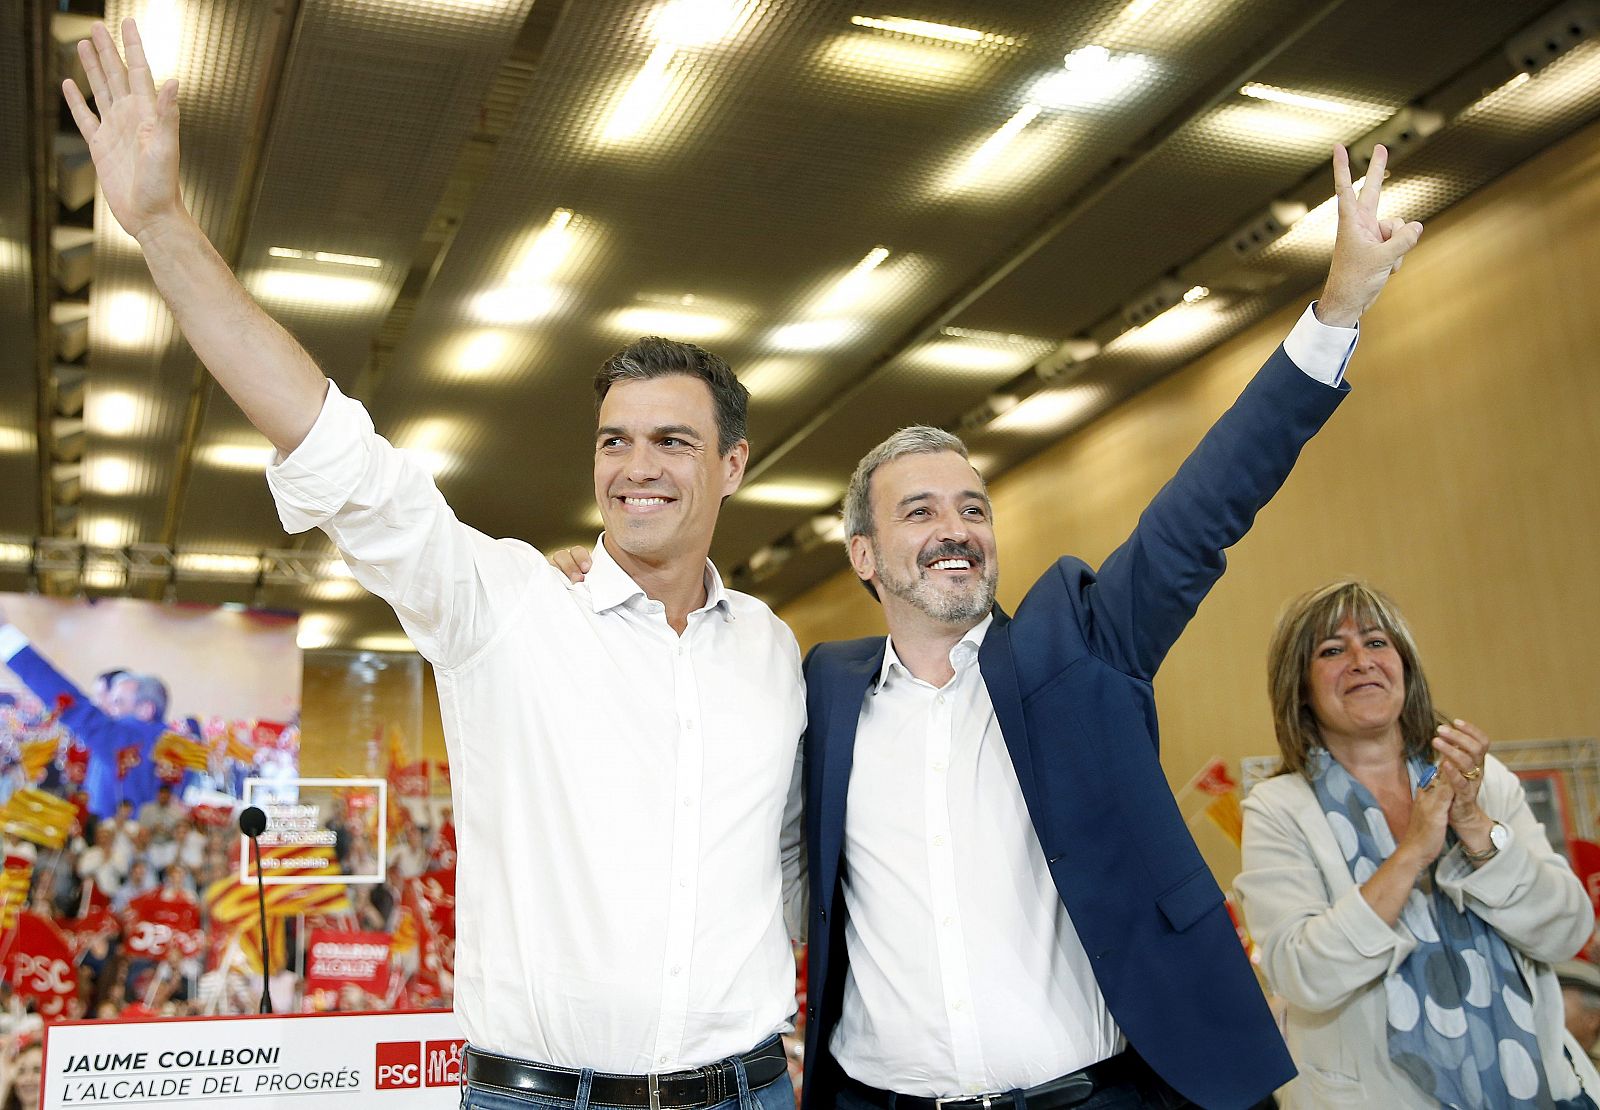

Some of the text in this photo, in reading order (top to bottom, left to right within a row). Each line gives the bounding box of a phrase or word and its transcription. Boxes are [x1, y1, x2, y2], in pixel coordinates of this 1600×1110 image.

[312, 942, 390, 960] COLLBONI
[12, 951, 76, 994] PSC
[311, 960, 378, 978] ALCALDE
[62, 1047, 281, 1073] JAUME COLLBONI
[62, 1065, 360, 1102] L'ALCALDE DEL PROGRÉS
[378, 1063, 419, 1086] PSC
